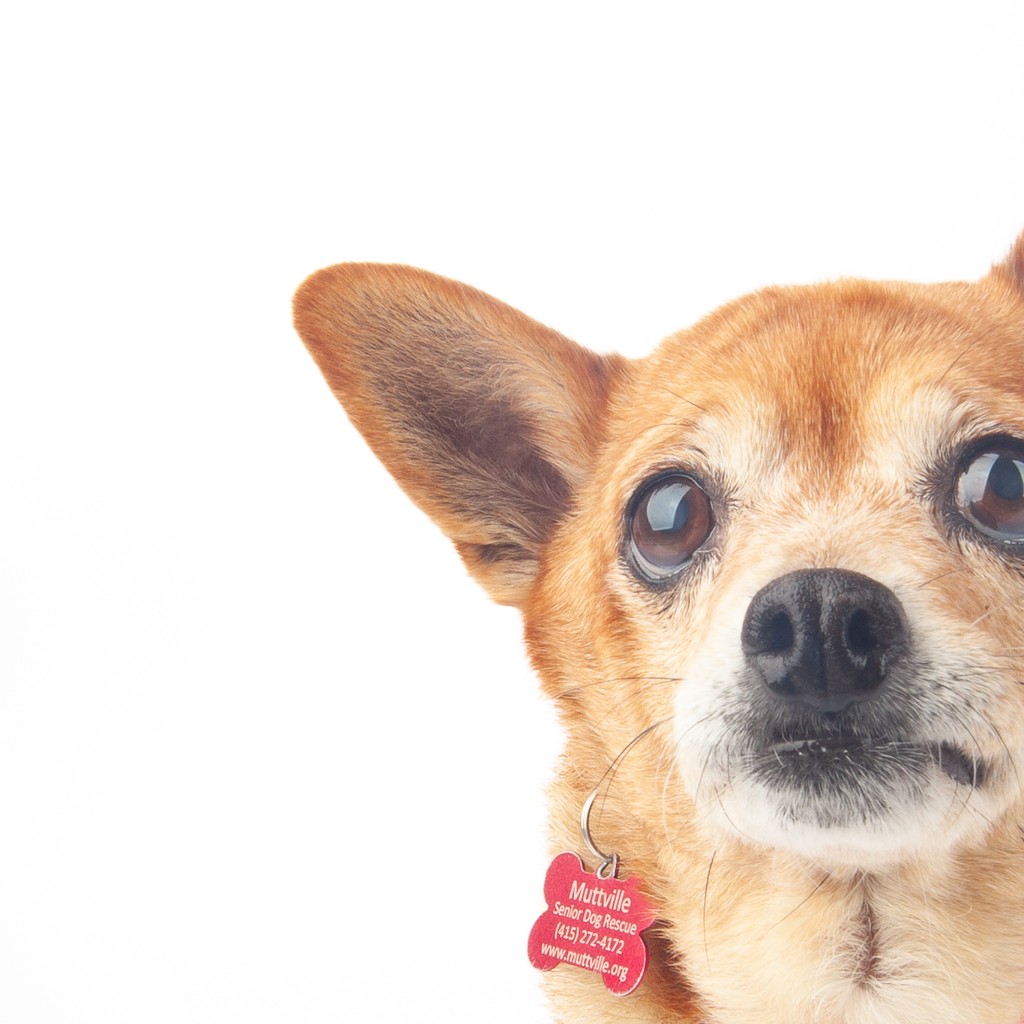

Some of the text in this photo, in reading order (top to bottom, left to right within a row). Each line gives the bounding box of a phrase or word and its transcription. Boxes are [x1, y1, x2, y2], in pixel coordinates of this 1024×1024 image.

[569, 880, 631, 913] Muttville
[553, 901, 637, 935] Senior Dog Rescue
[554, 922, 625, 955] (415) 272-4172
[541, 943, 629, 982] www.muttville.org
